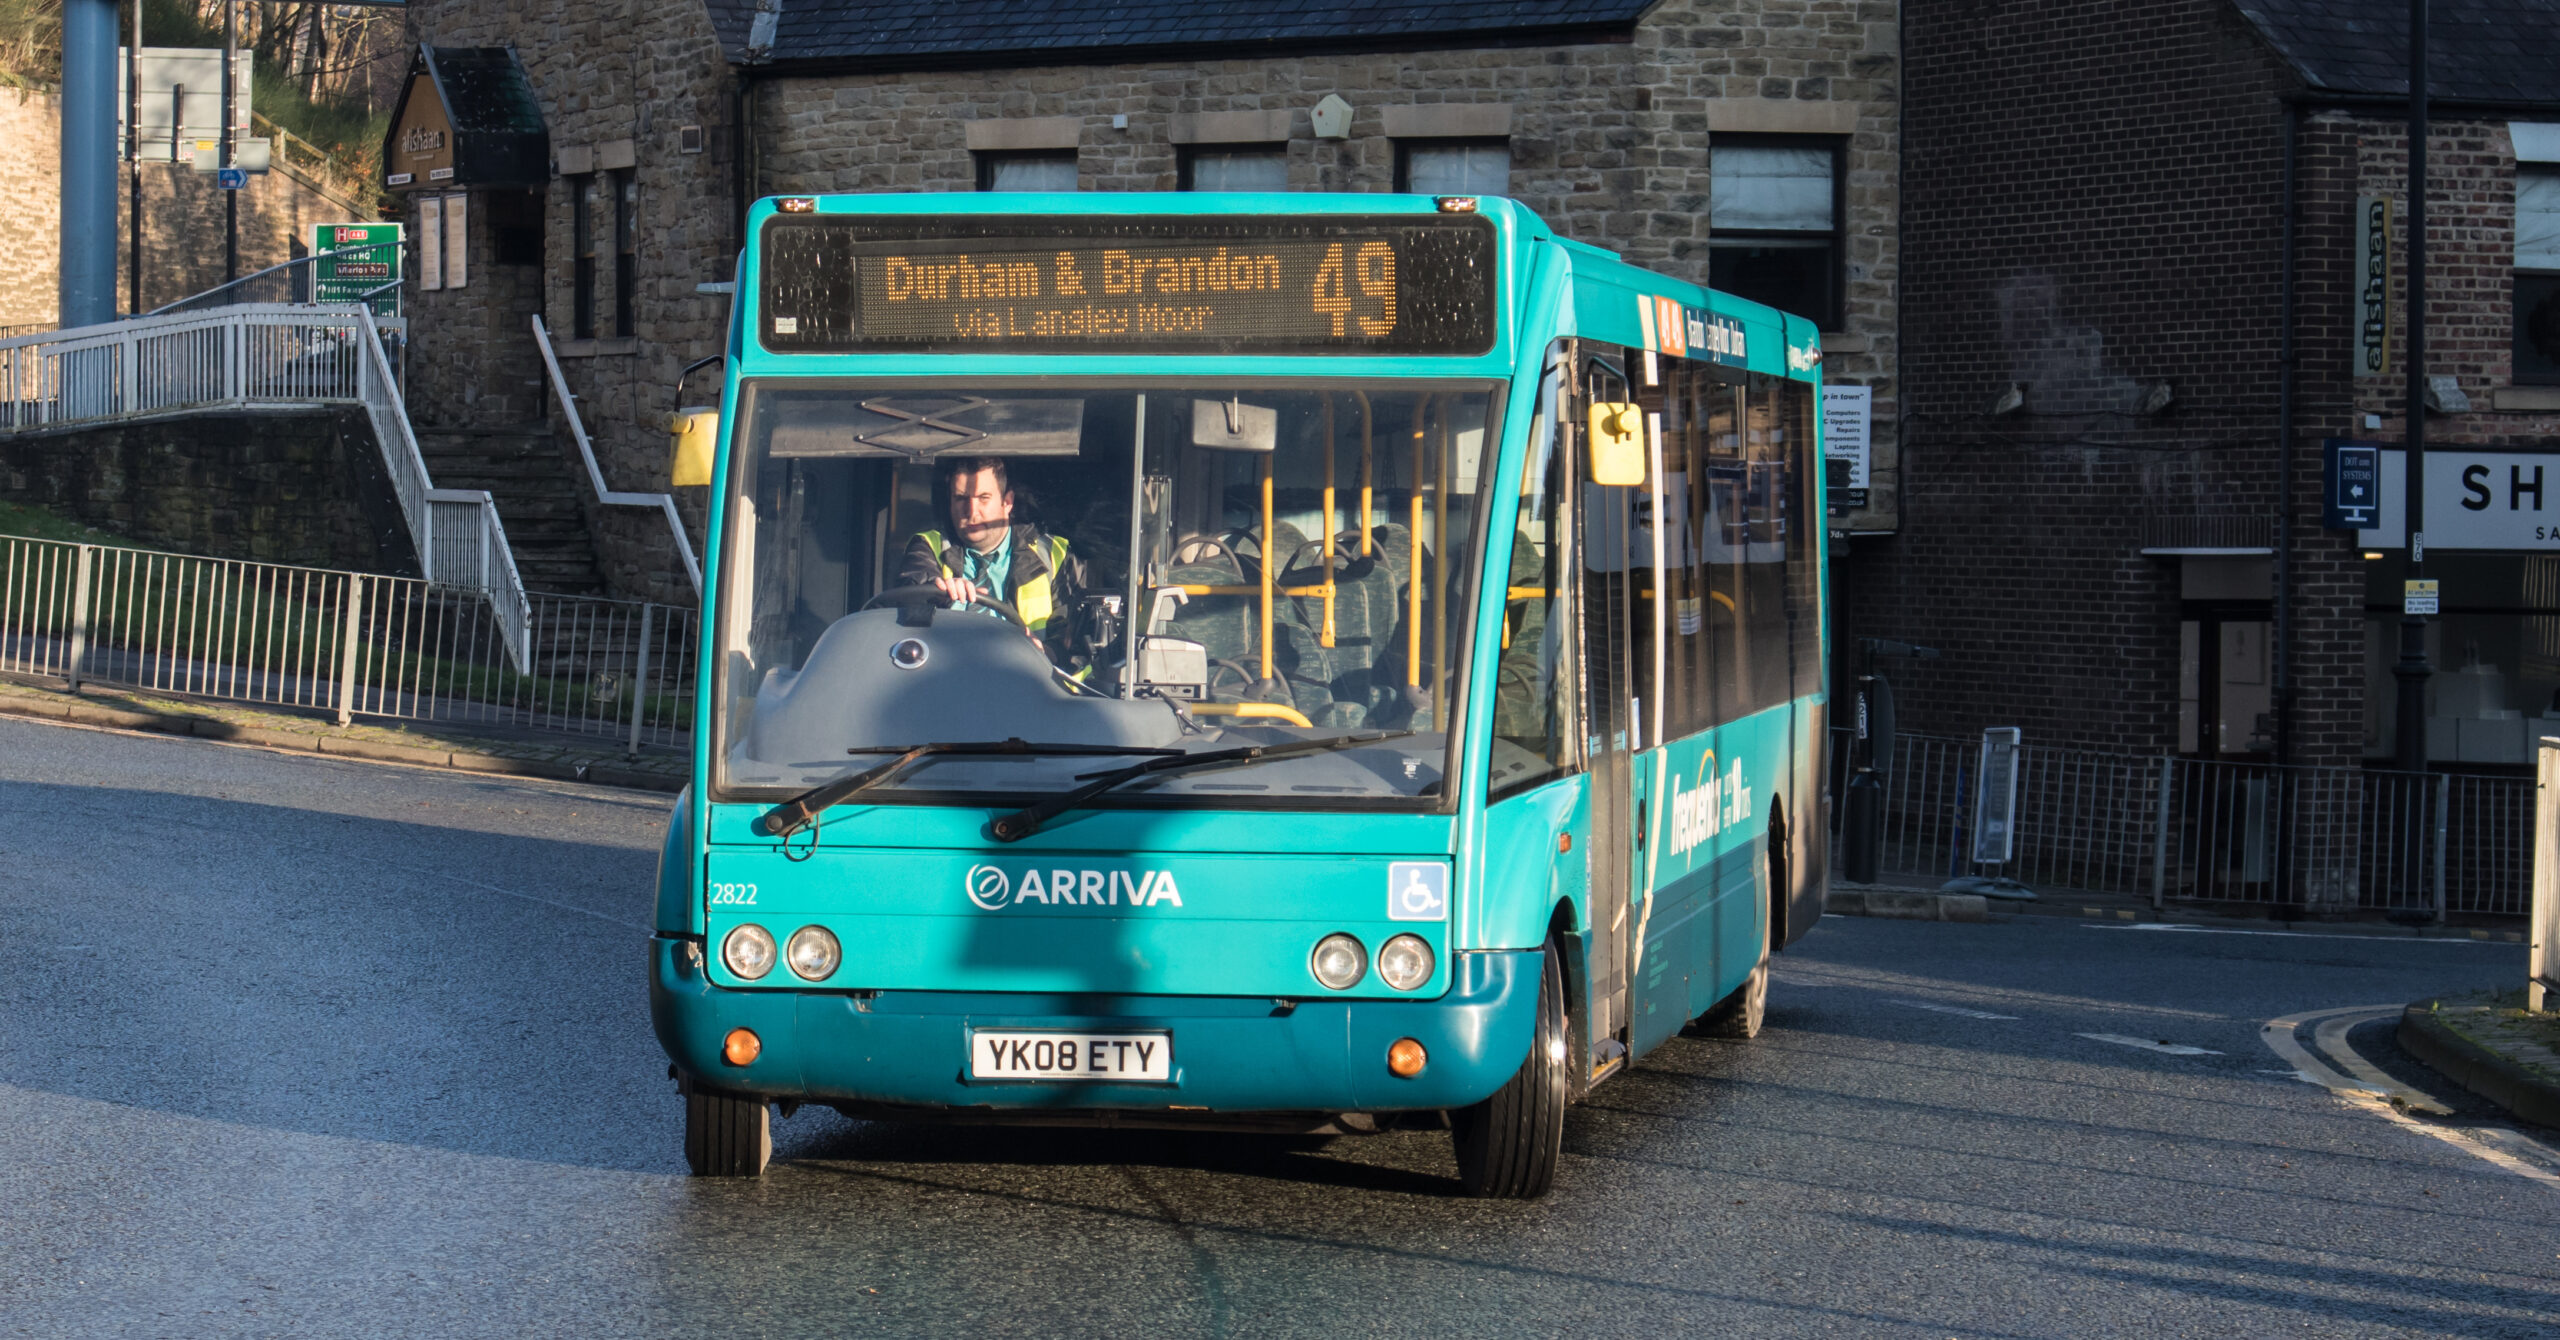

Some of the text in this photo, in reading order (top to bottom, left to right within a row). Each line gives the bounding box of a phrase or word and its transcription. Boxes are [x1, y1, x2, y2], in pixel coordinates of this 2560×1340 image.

[402, 128, 441, 153] alishaan
[886, 241, 1397, 337] Durham & Brandon 49
[2364, 201, 2385, 371] alishaan
[955, 307, 1000, 337] via
[1138, 302, 1213, 332] Moor
[2343, 470, 2372, 480] SYSTEMS
[2344, 456, 2358, 467] DOT
[2460, 464, 2544, 511] SH
[2414, 533, 2422, 561] 670
[711, 883, 758, 905] 2822
[1014, 868, 1184, 908] ARRIVA
[988, 1039, 1155, 1073] YK08 ETY
